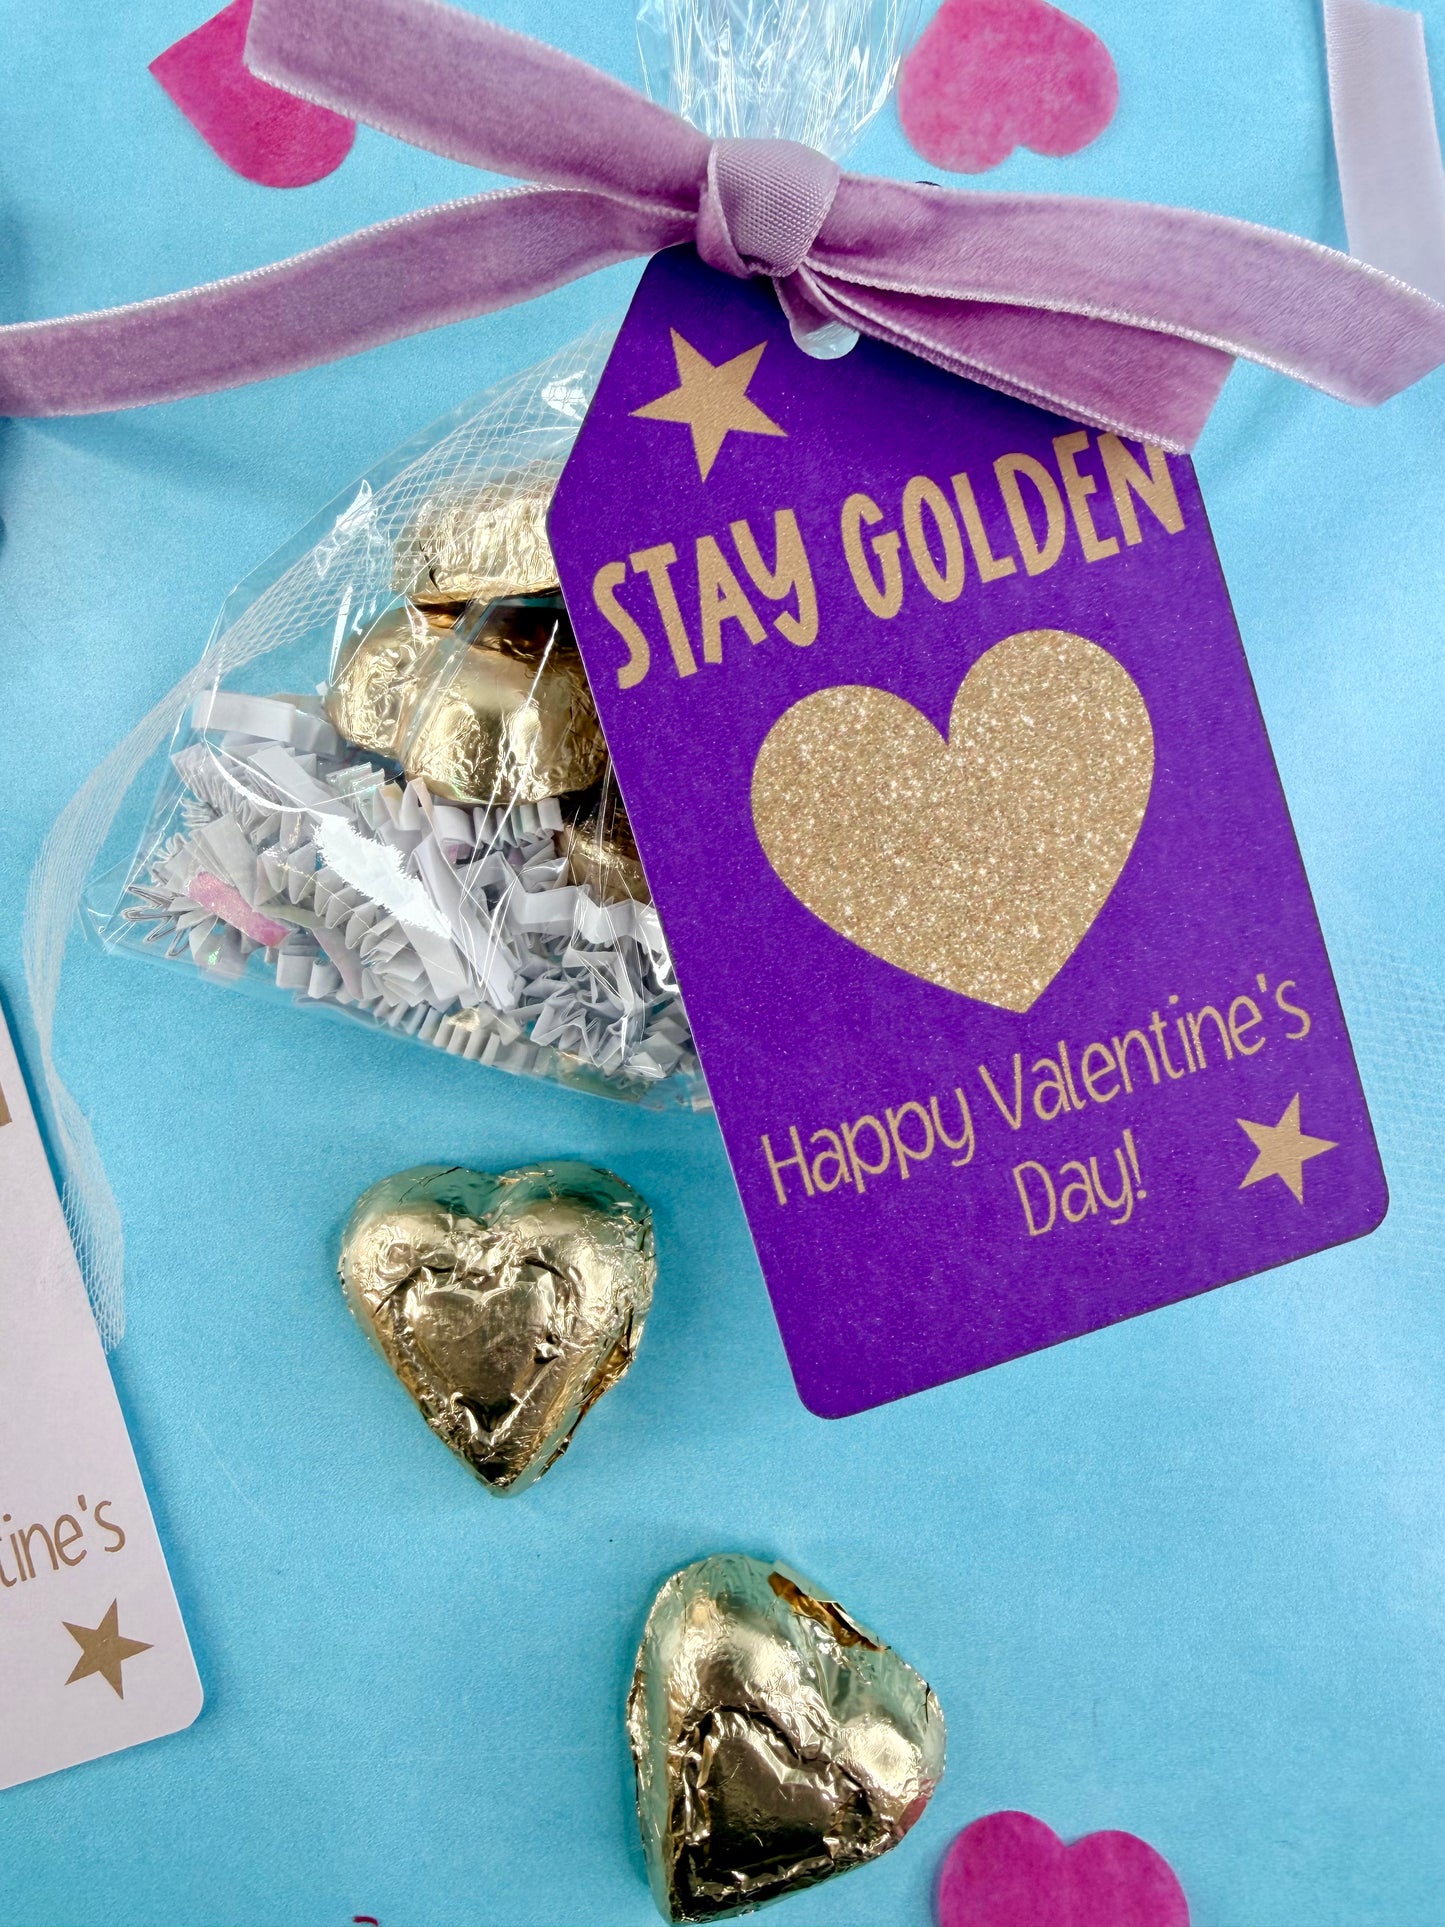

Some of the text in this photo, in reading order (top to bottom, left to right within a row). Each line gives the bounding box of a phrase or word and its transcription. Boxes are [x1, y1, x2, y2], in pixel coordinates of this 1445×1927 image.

[592, 430, 1186, 690] STAY GOLDEN
[761, 973, 1312, 1206] Happy Valentine's
[1012, 1129, 1147, 1237] Day!
